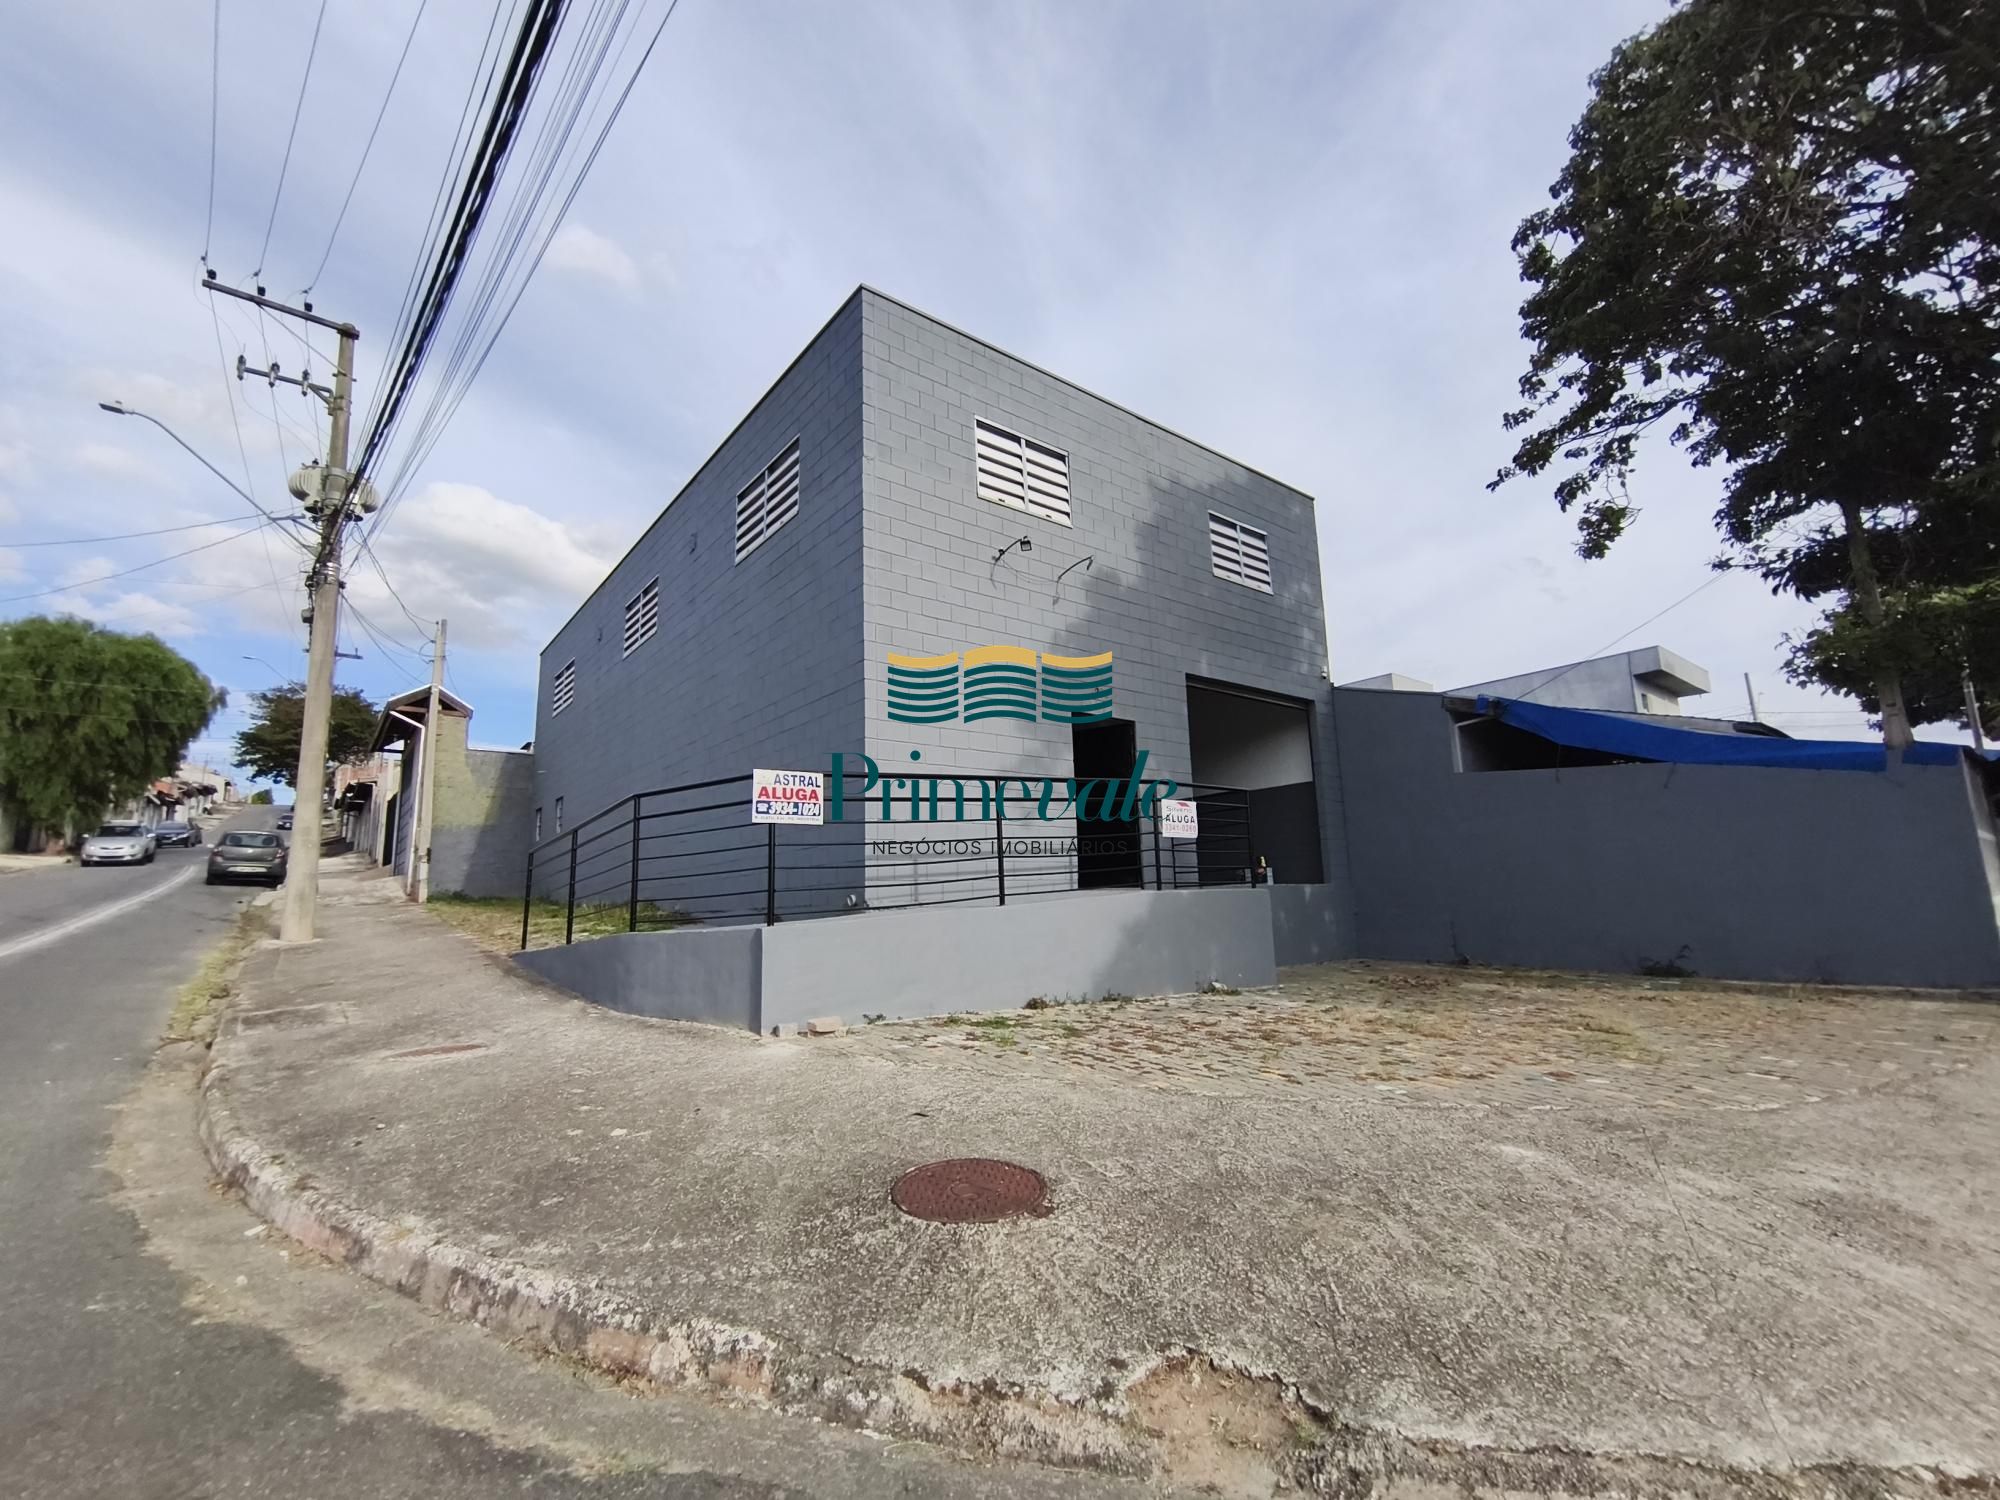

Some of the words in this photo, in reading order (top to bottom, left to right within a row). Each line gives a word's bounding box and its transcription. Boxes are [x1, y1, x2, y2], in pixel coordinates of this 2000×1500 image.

[774, 773, 821, 788] ASTRAL
[757, 786, 819, 801] ALUGA
[1165, 814, 1195, 823] ALUGA
